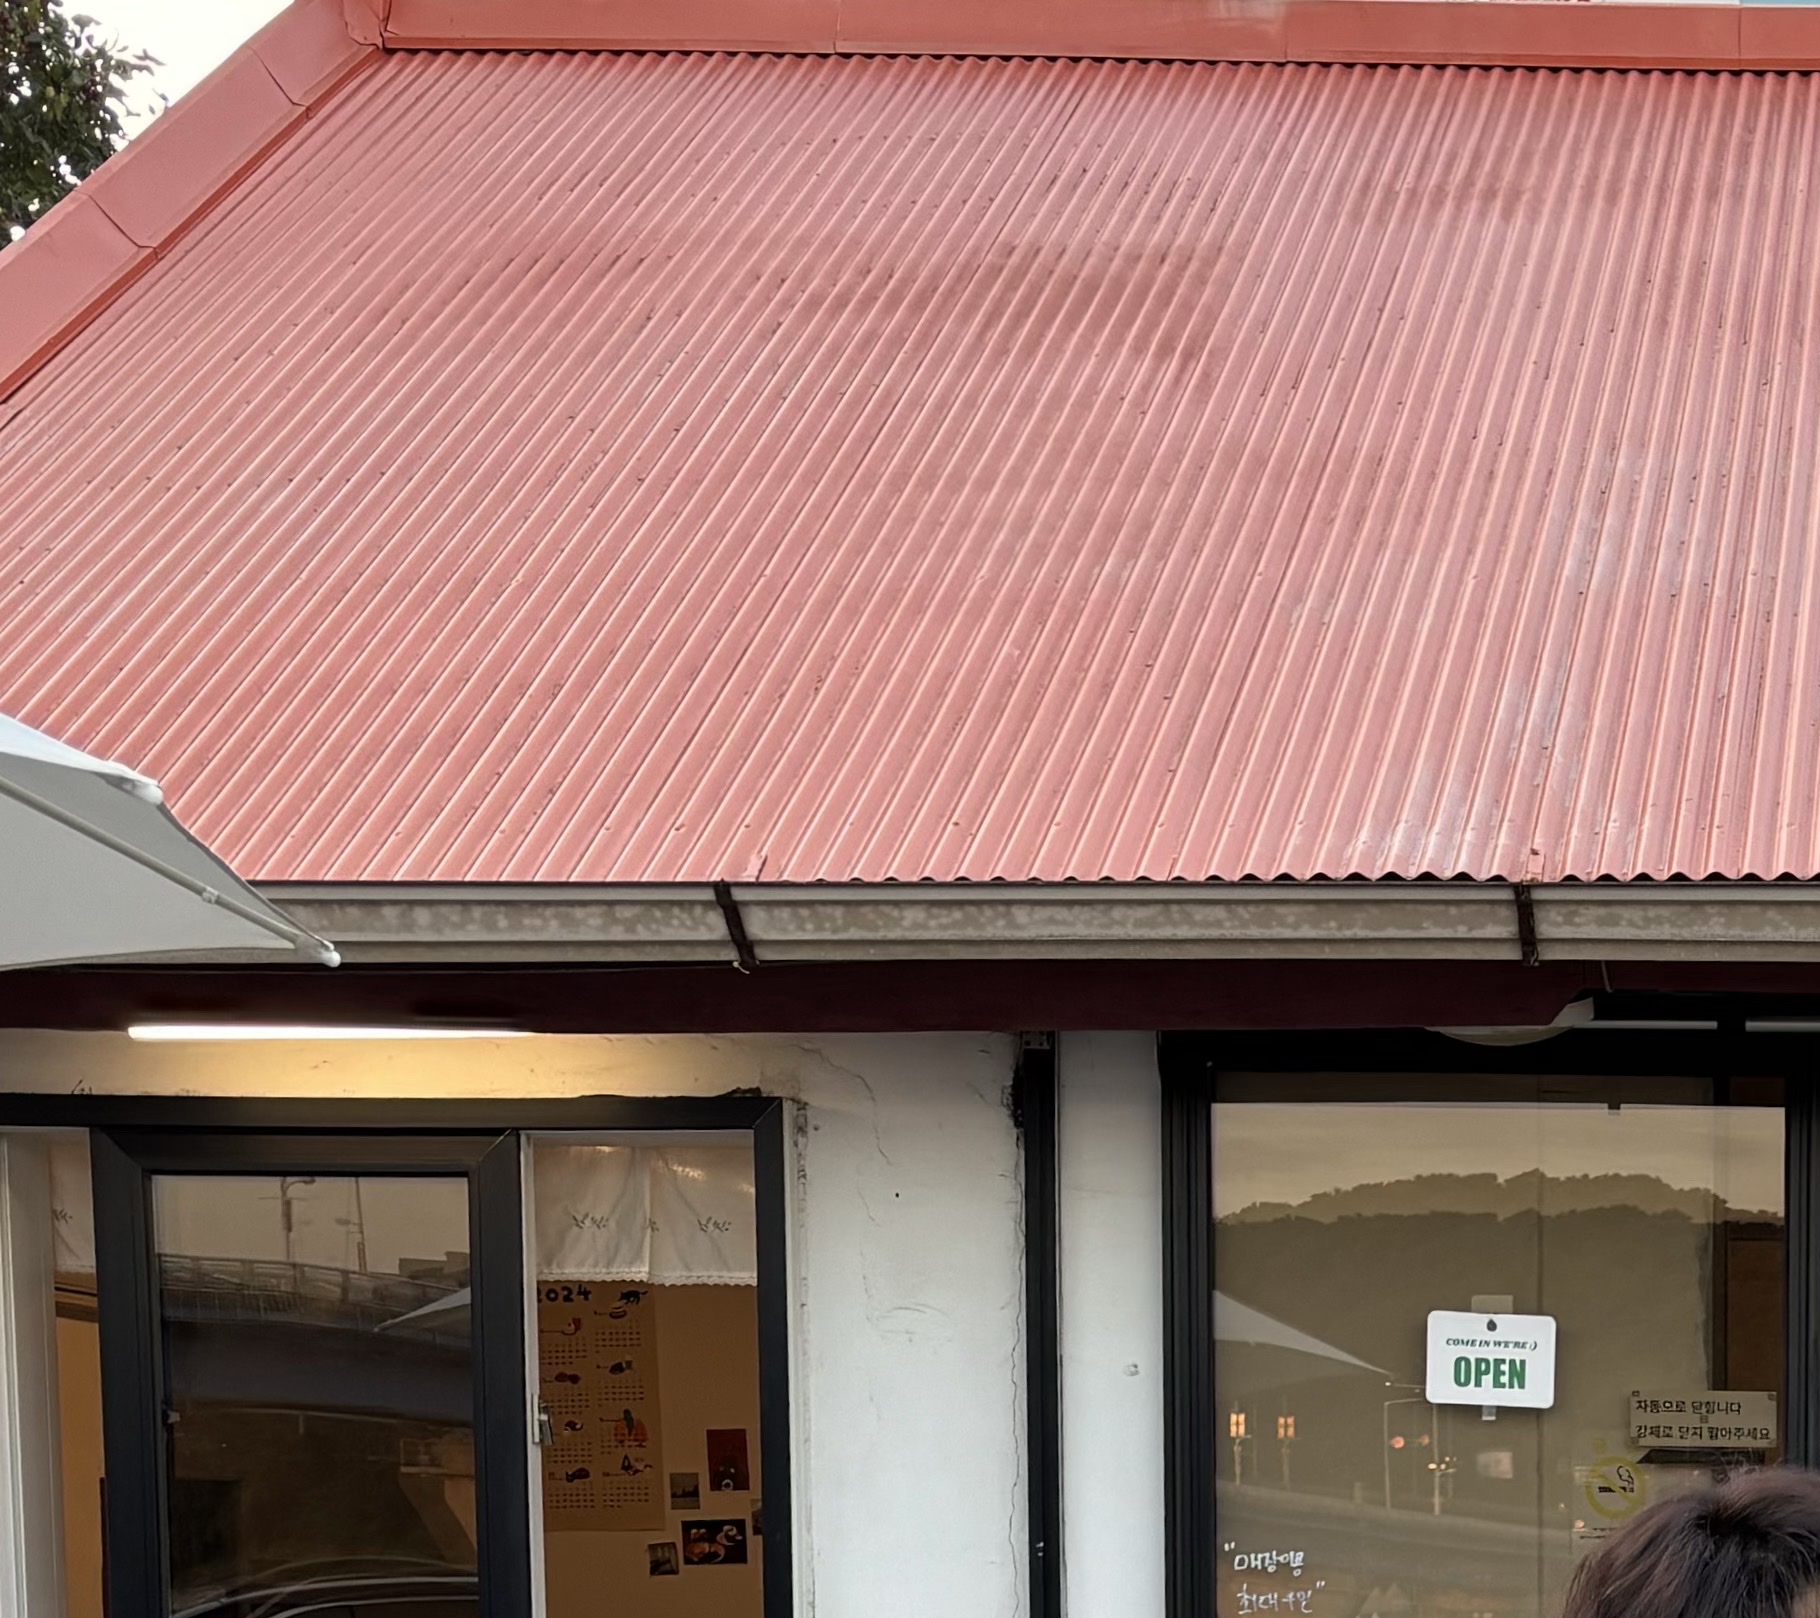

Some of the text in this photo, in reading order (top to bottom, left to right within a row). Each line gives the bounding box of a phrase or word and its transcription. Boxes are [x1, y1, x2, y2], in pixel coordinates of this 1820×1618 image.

[1446, 1338, 1478, 1348] COME
[1478, 1339, 1491, 1348] IN
[1453, 1356, 1526, 1389] OPEN
[1636, 1400, 1741, 1414] 자동으로 닫힙니다
[1636, 1425, 1674, 1438] 강제로
